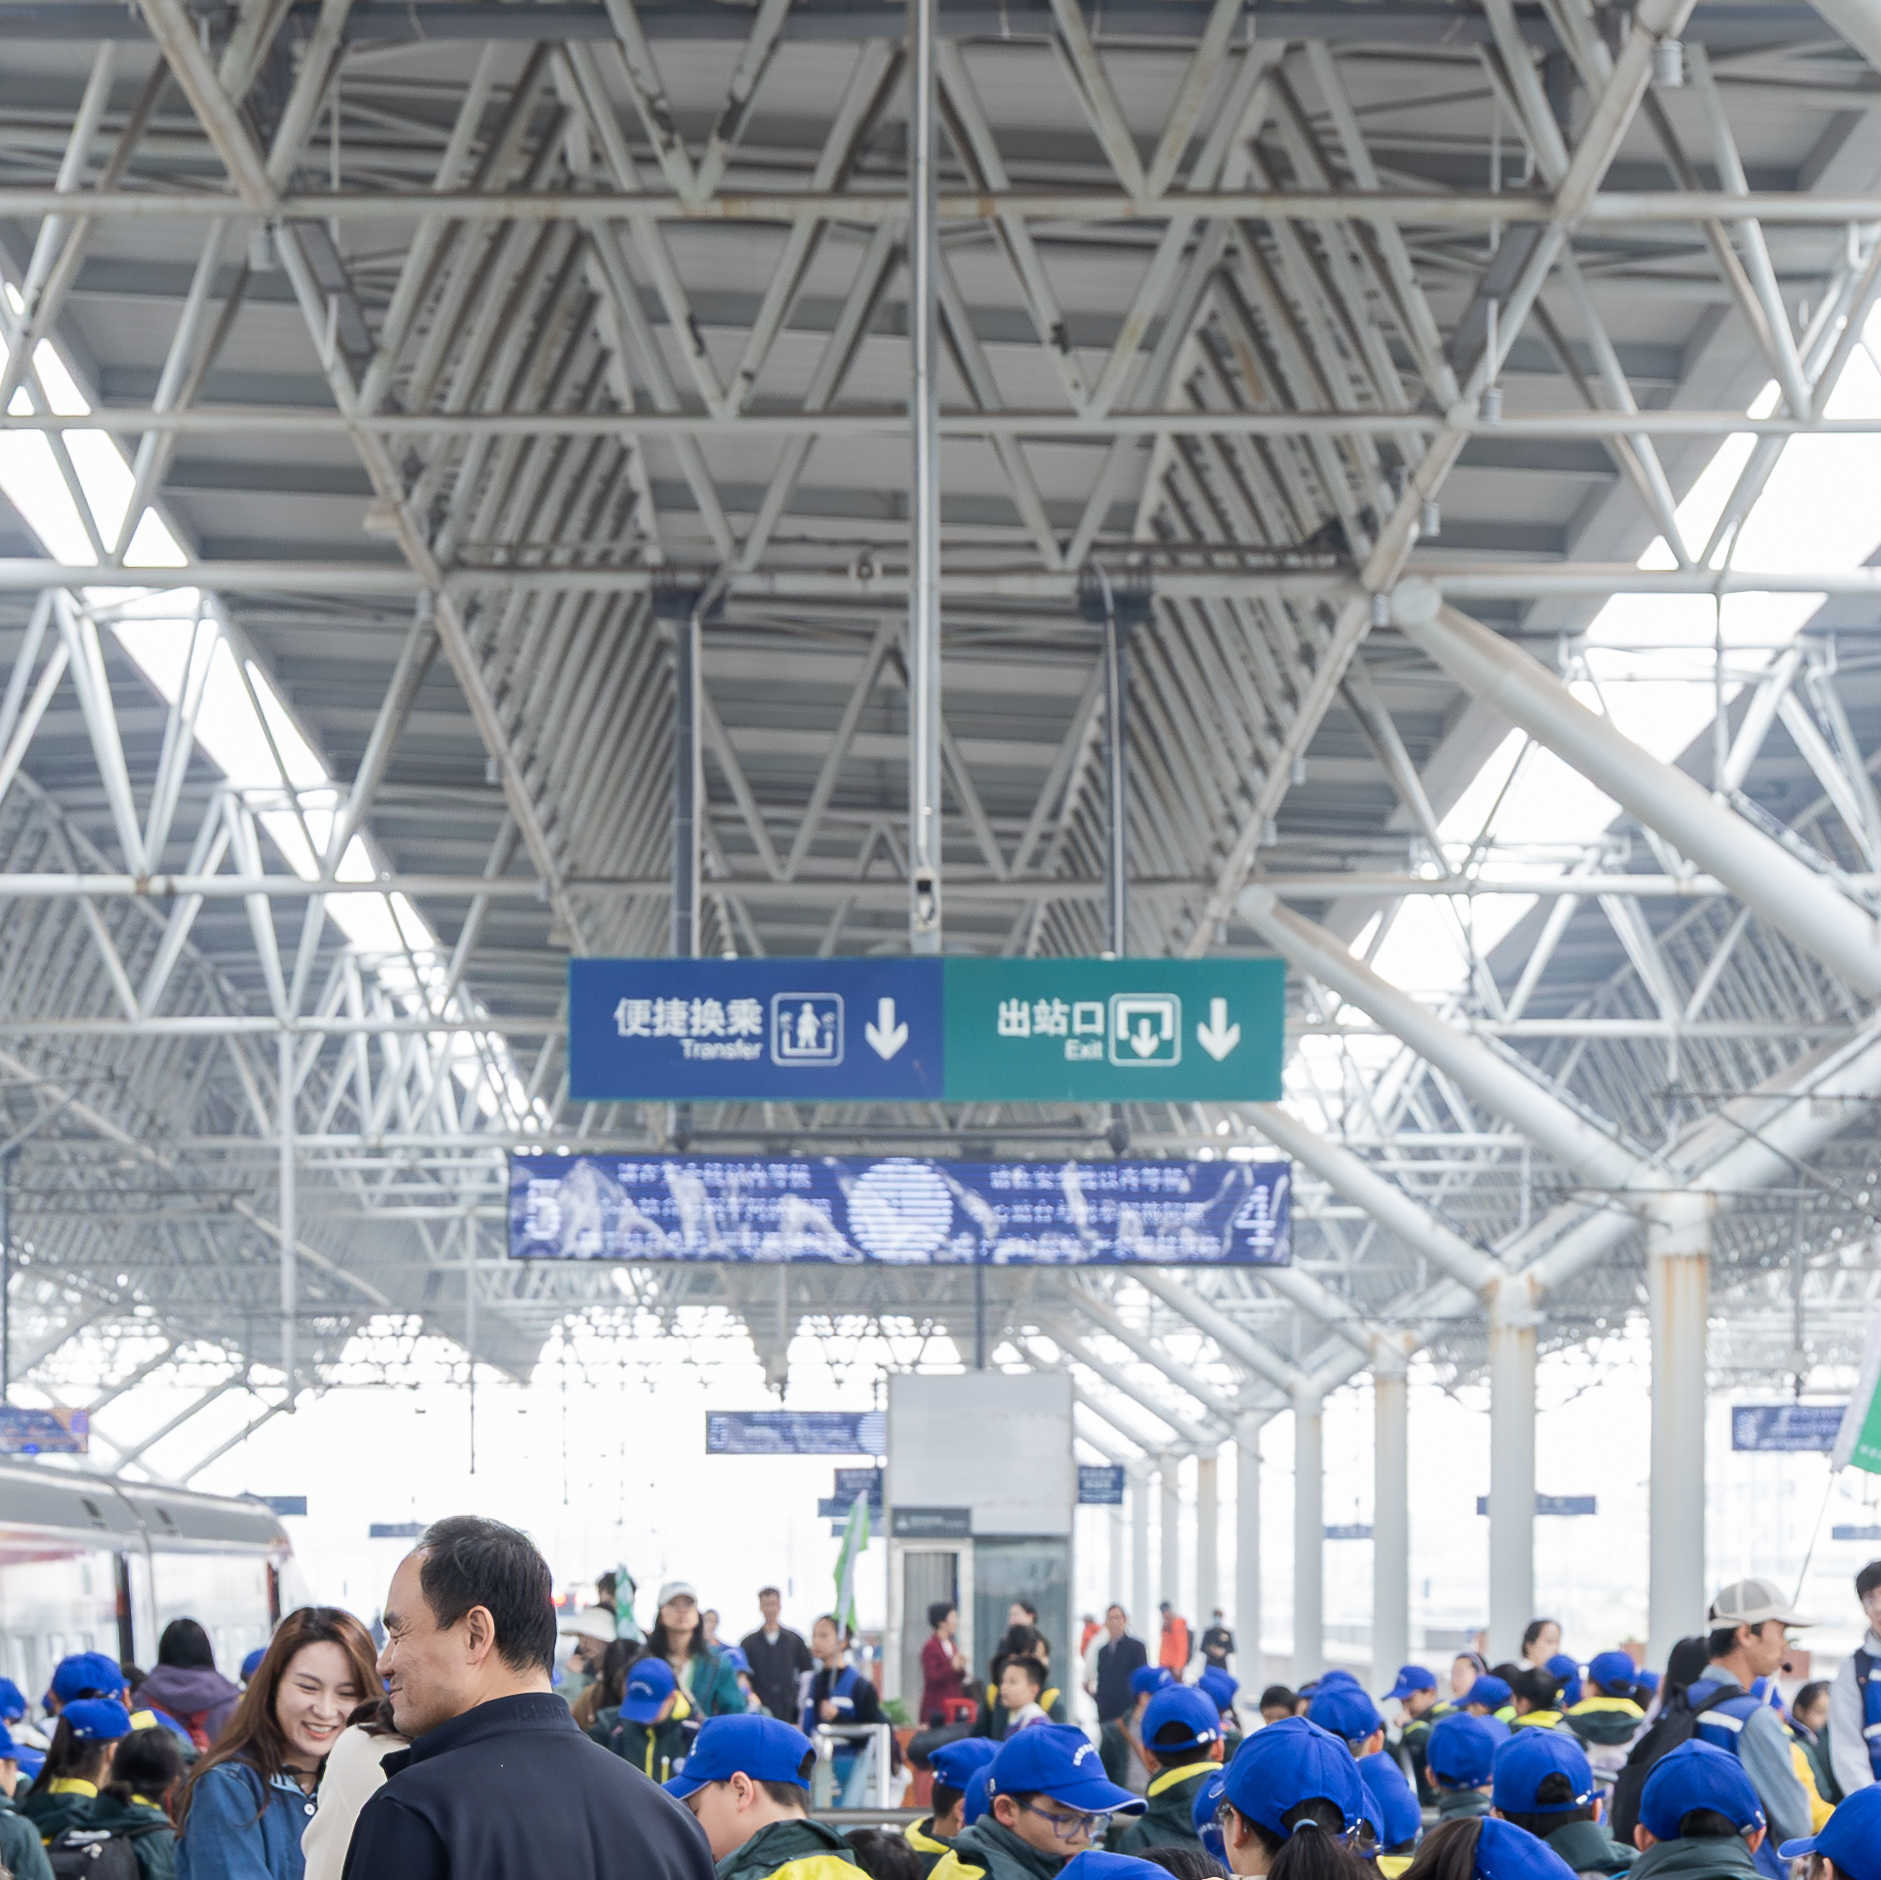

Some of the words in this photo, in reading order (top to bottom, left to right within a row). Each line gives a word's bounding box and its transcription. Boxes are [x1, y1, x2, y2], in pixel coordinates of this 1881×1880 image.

[614, 997, 763, 1037] 便捷换乘
[997, 998, 1104, 1037] 出站口
[679, 1038, 763, 1060] Transfer
[1064, 1039, 1103, 1060] Exit
[1234, 1186, 1276, 1257] 4
